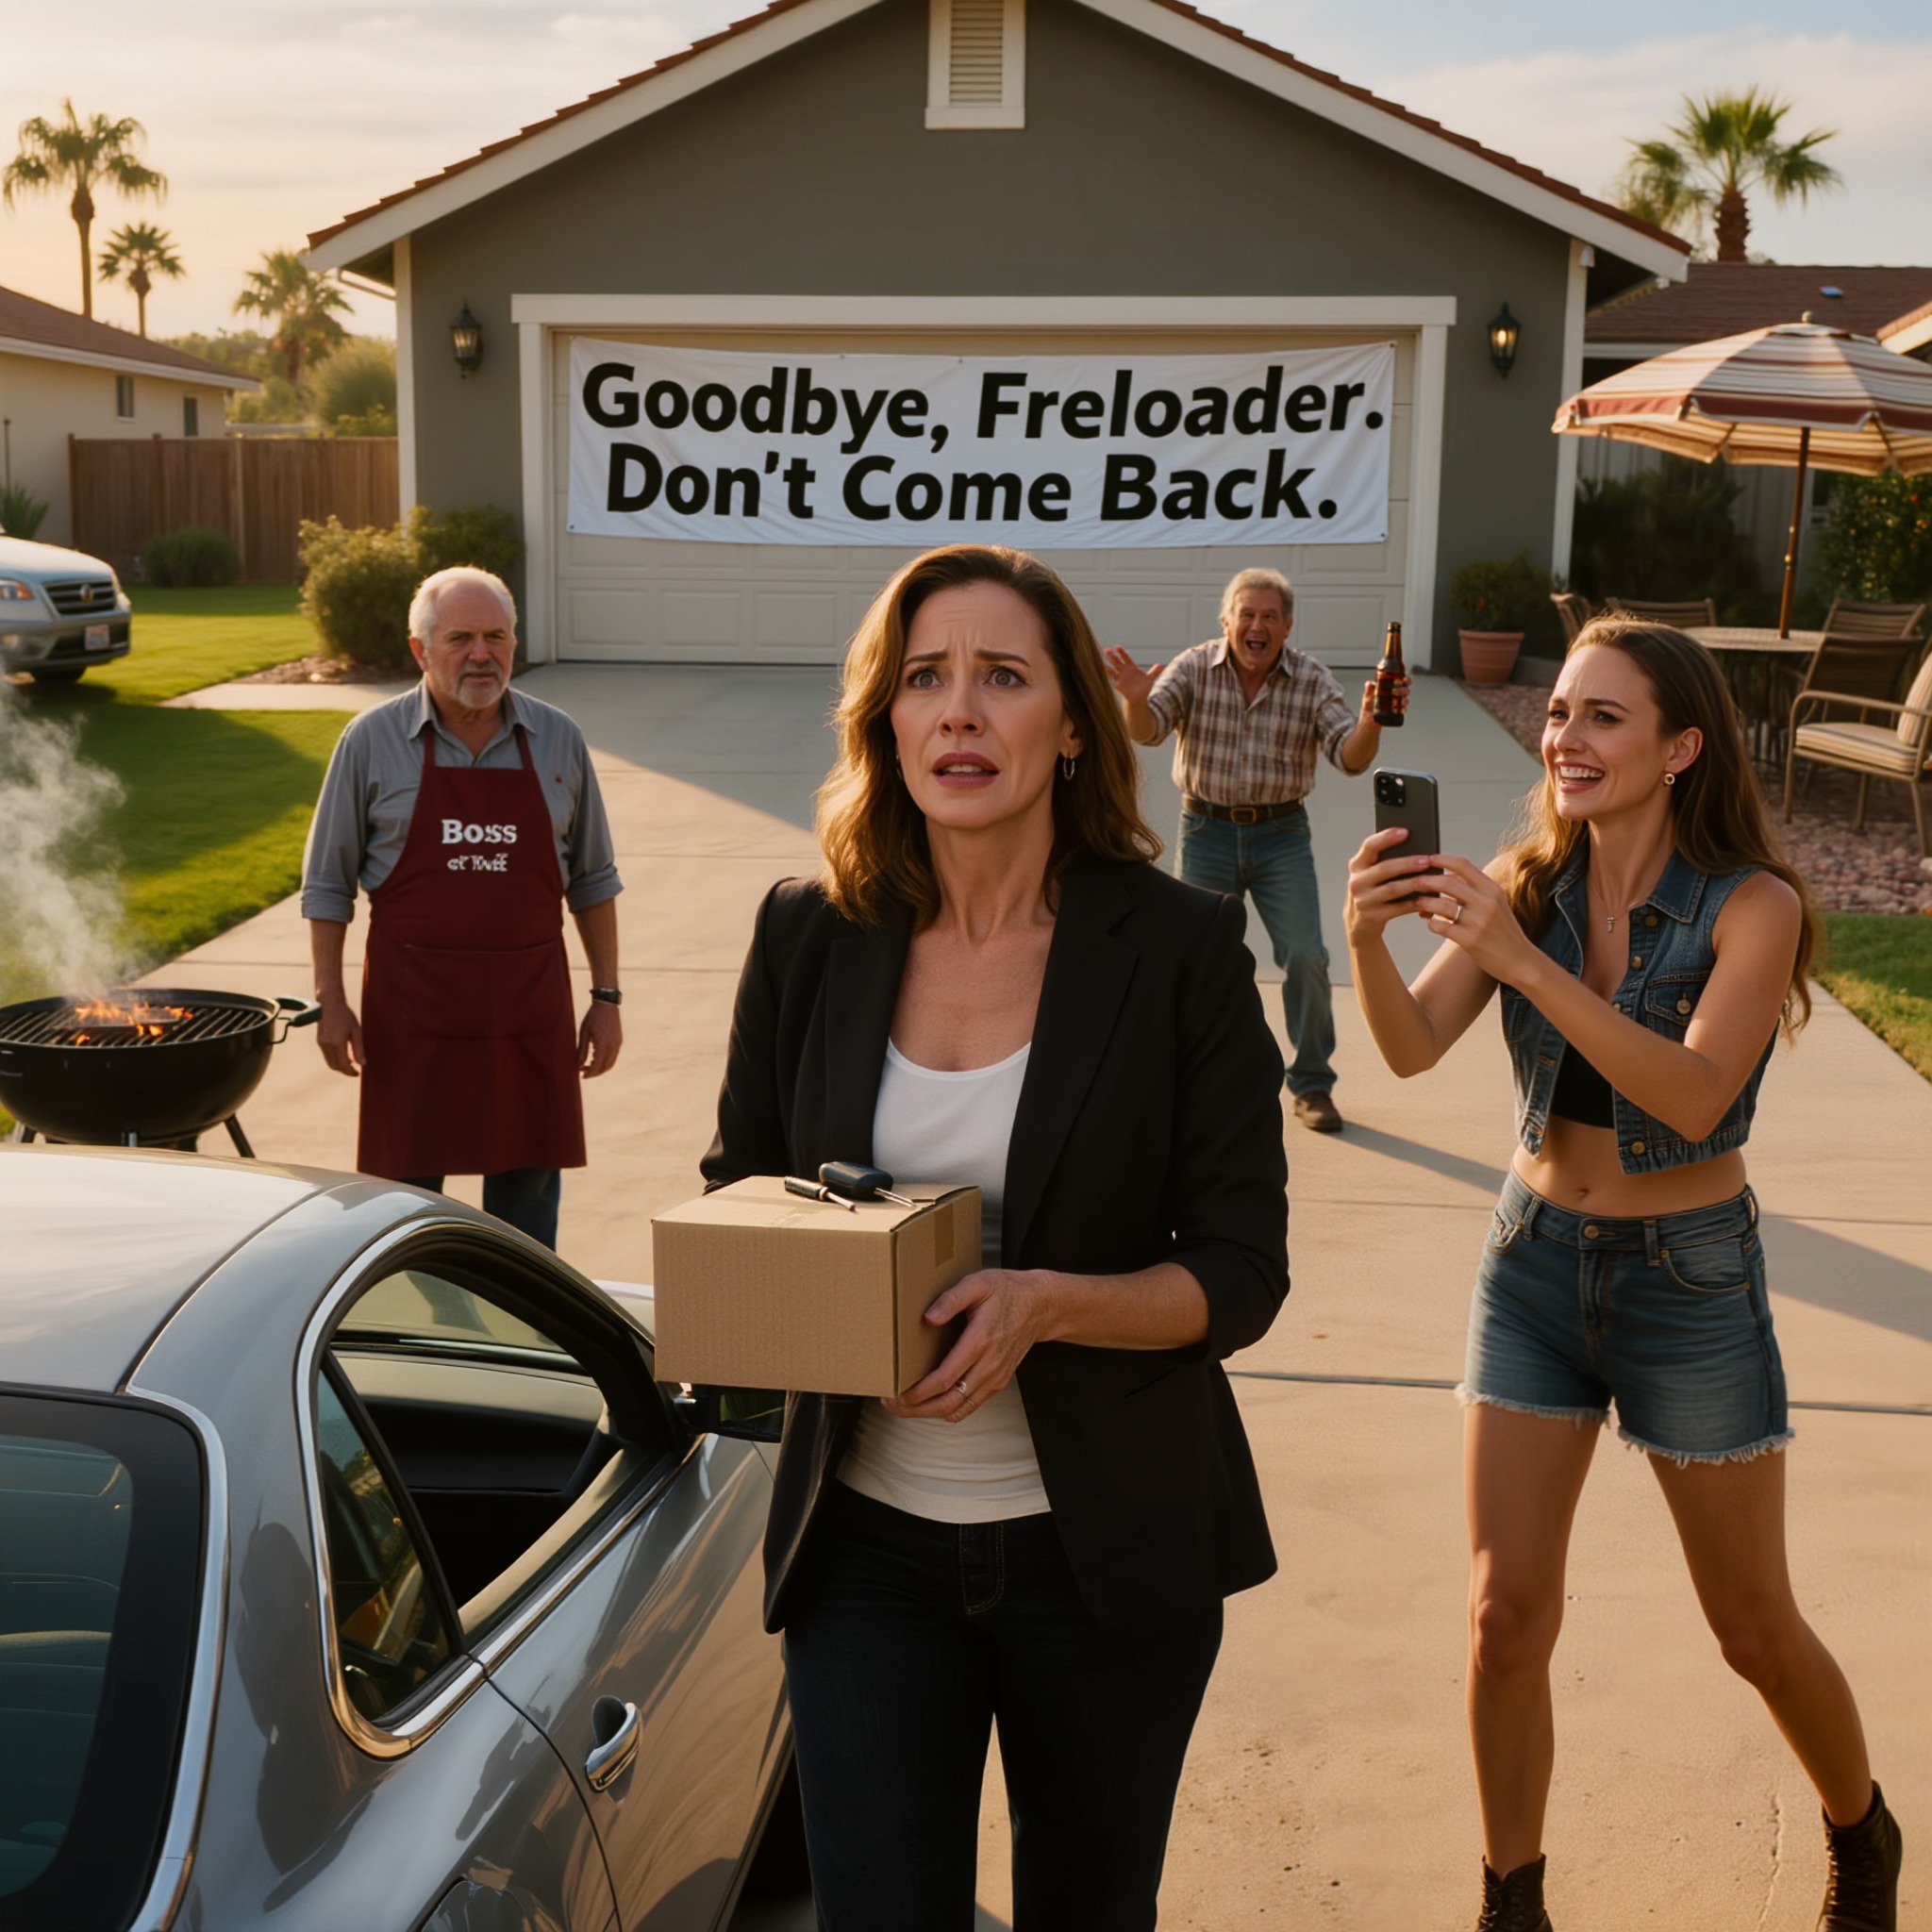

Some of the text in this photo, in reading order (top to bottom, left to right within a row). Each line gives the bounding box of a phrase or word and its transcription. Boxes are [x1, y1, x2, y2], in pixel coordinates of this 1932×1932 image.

[582, 361, 1384, 455] Goodbye, Freloader.
[607, 442, 1338, 523] Don't Come Back.
